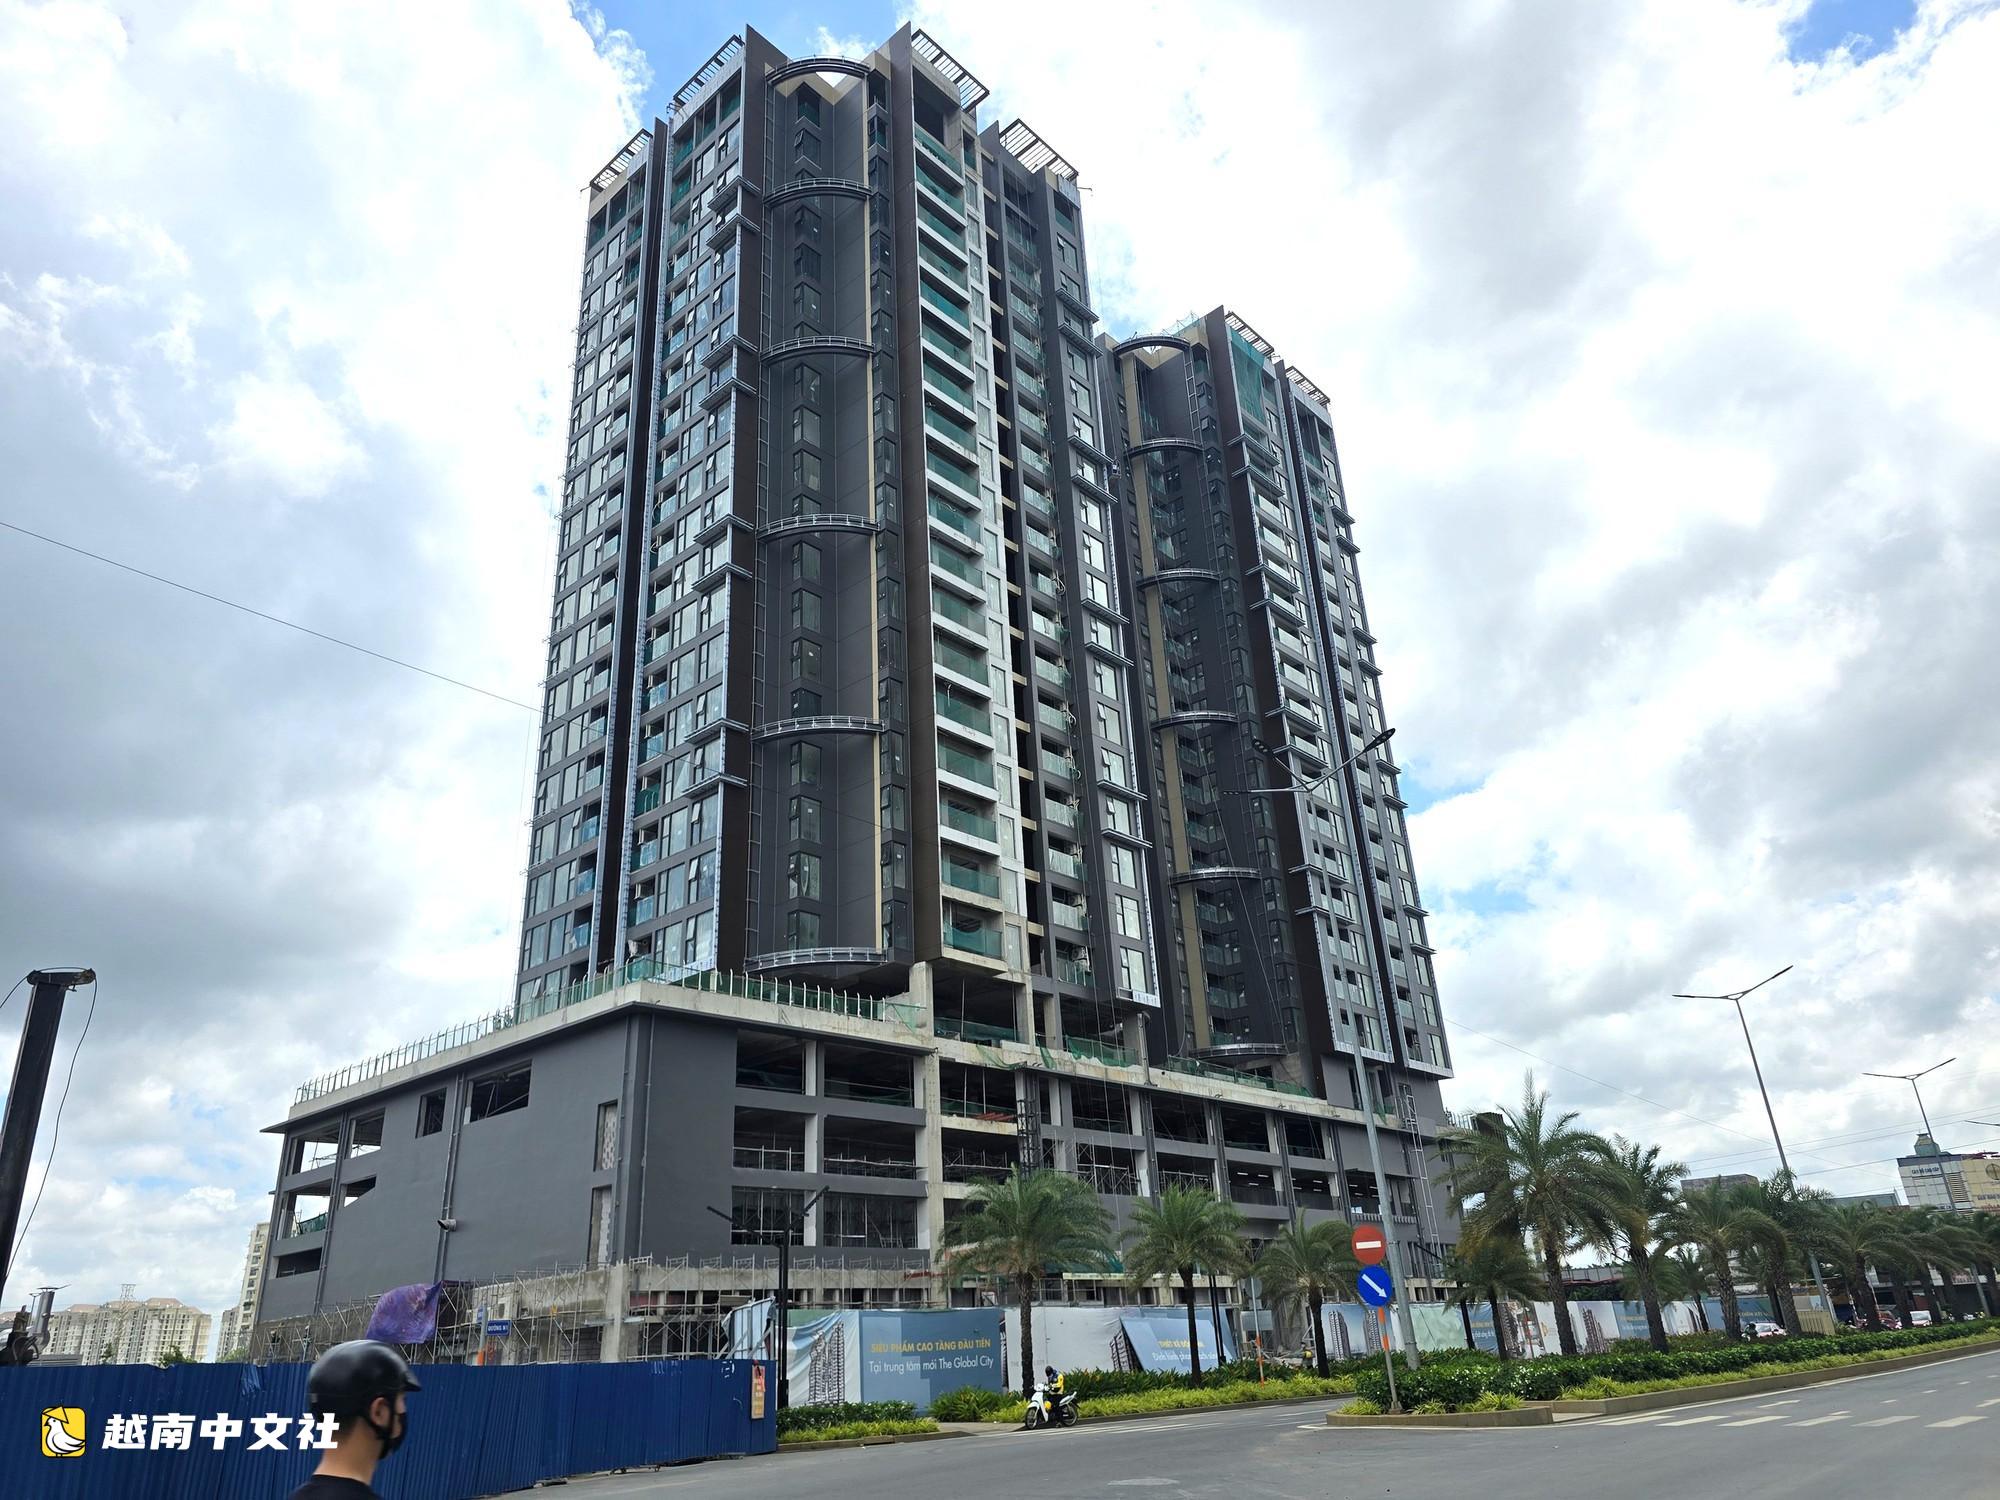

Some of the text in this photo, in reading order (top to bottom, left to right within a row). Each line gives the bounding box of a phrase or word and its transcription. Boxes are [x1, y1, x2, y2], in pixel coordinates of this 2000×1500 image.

[916, 1341, 933, 1352] CAO
[935, 1339, 957, 1351] TẦNG
[958, 1338, 974, 1350] ĐẦU
[868, 1355, 994, 1375] Tại trung tâm mới The Global City
